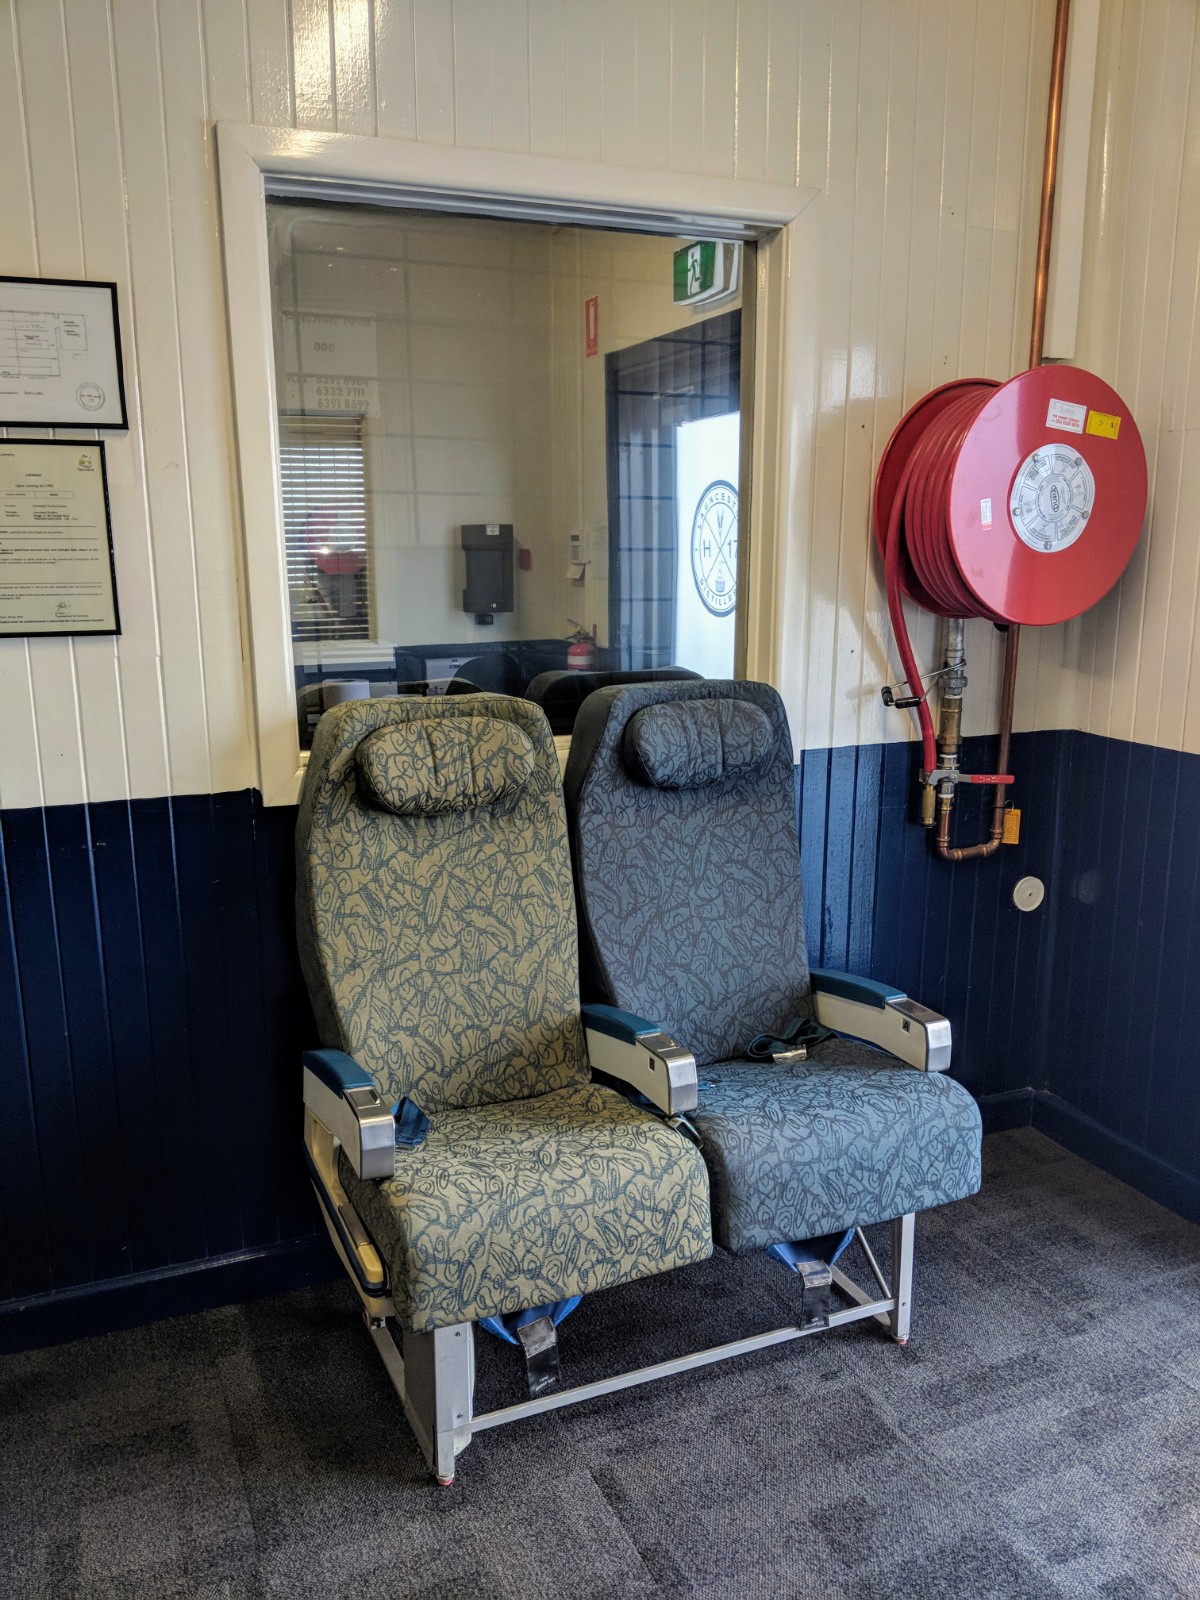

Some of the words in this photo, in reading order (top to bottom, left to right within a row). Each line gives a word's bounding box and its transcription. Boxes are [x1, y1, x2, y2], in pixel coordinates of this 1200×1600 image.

[316, 386, 343, 396] 6332
[346, 387, 365, 397] 7111
[317, 398, 341, 408] 6391
[703, 539, 711, 558] H
